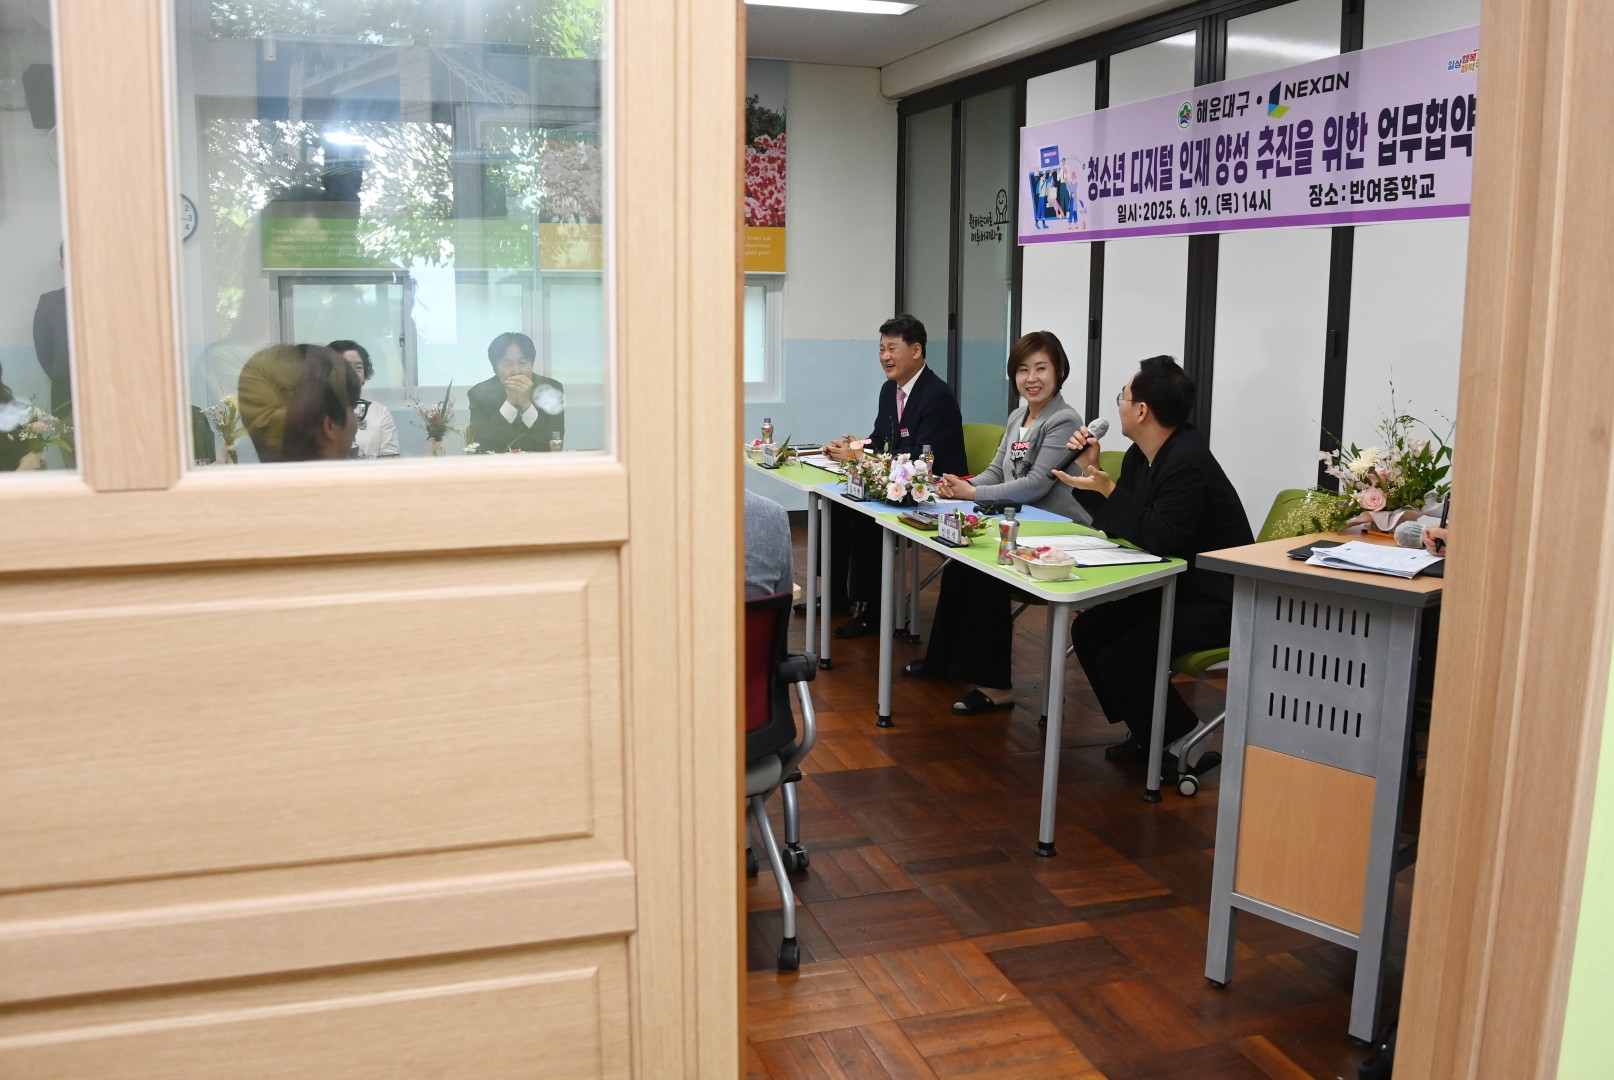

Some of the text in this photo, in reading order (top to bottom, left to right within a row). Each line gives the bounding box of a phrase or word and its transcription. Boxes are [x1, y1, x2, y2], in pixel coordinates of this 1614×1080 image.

[1284, 71, 1350, 100] NEXON
[1196, 91, 1250, 123] 해운대구
[1087, 93, 1477, 201] 청소년 디지털 인재 양성 추진을 위한 업무협약
[1180, 198, 1190, 218] 6.
[1195, 196, 1211, 216] 19.
[1216, 192, 1239, 214] (목)
[1242, 188, 1271, 212] 14시
